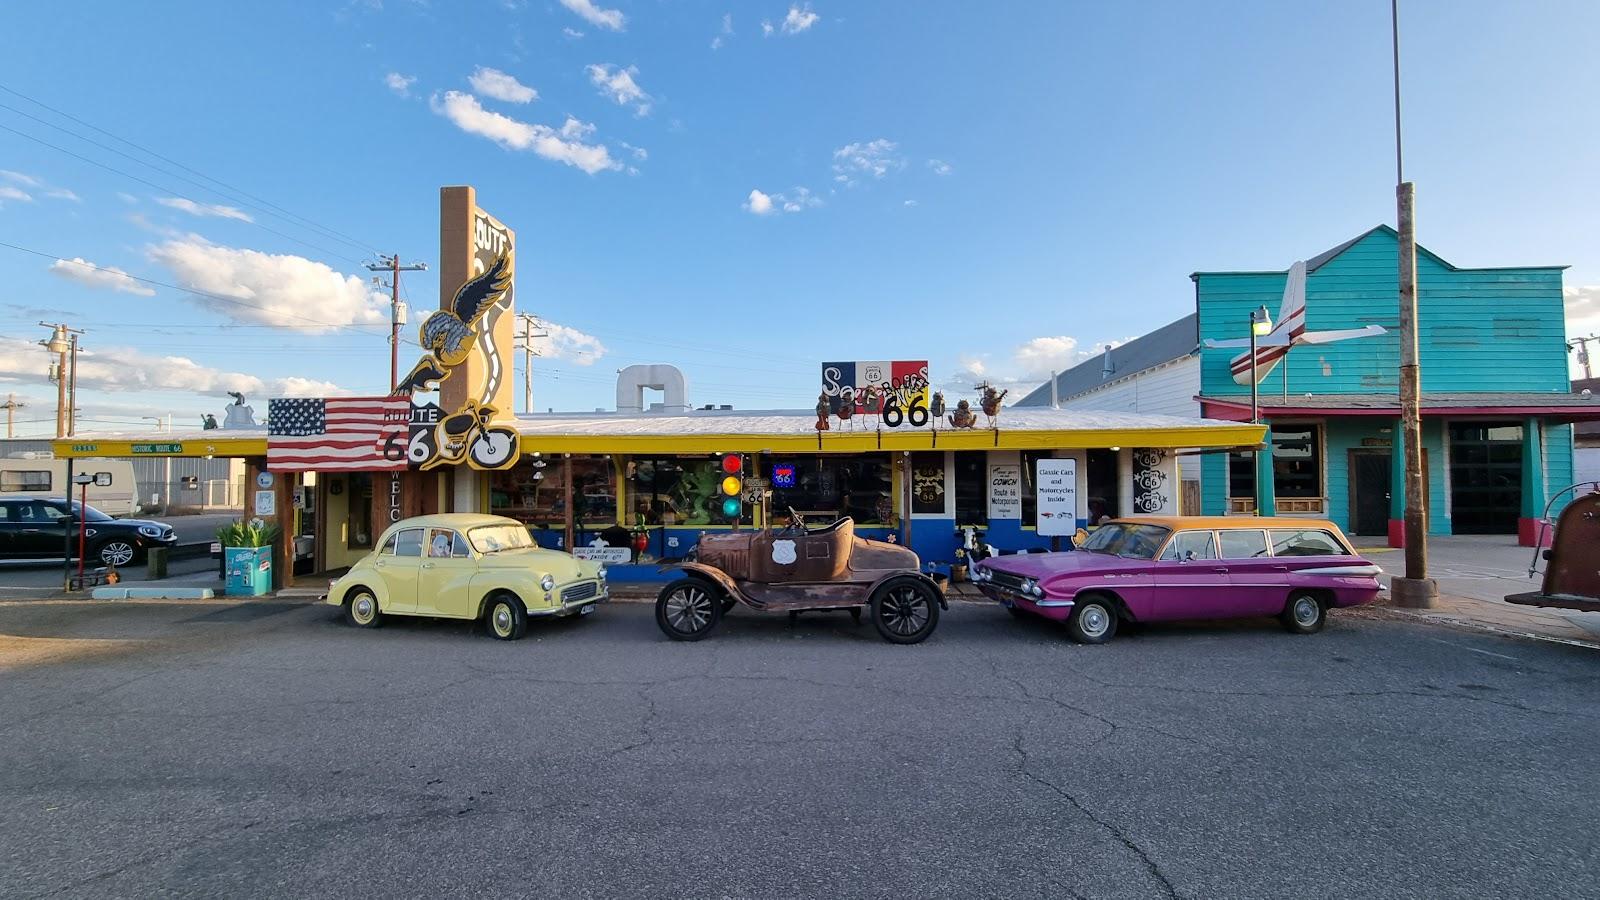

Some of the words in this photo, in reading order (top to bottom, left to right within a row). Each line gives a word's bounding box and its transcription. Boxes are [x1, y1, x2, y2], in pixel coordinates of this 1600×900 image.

[384, 408, 438, 422] ROUTE
[882, 394, 929, 428] 66
[131, 445, 152, 453] HISTORIC
[173, 444, 182, 452] 66
[384, 427, 431, 464] 66
[1144, 455, 1156, 464] 66
[745, 478, 768, 487] ROUTE
[776, 474, 791, 483] 66
[992, 478, 1018, 486] COWCH
[1144, 478, 1157, 487] 66
[993, 486, 1008, 496] Route
[1010, 487, 1016, 496] 66
[1039, 487, 1075, 495] Motorcycles
[748, 493, 763, 503] 66
[1145, 500, 1157, 509] 66
